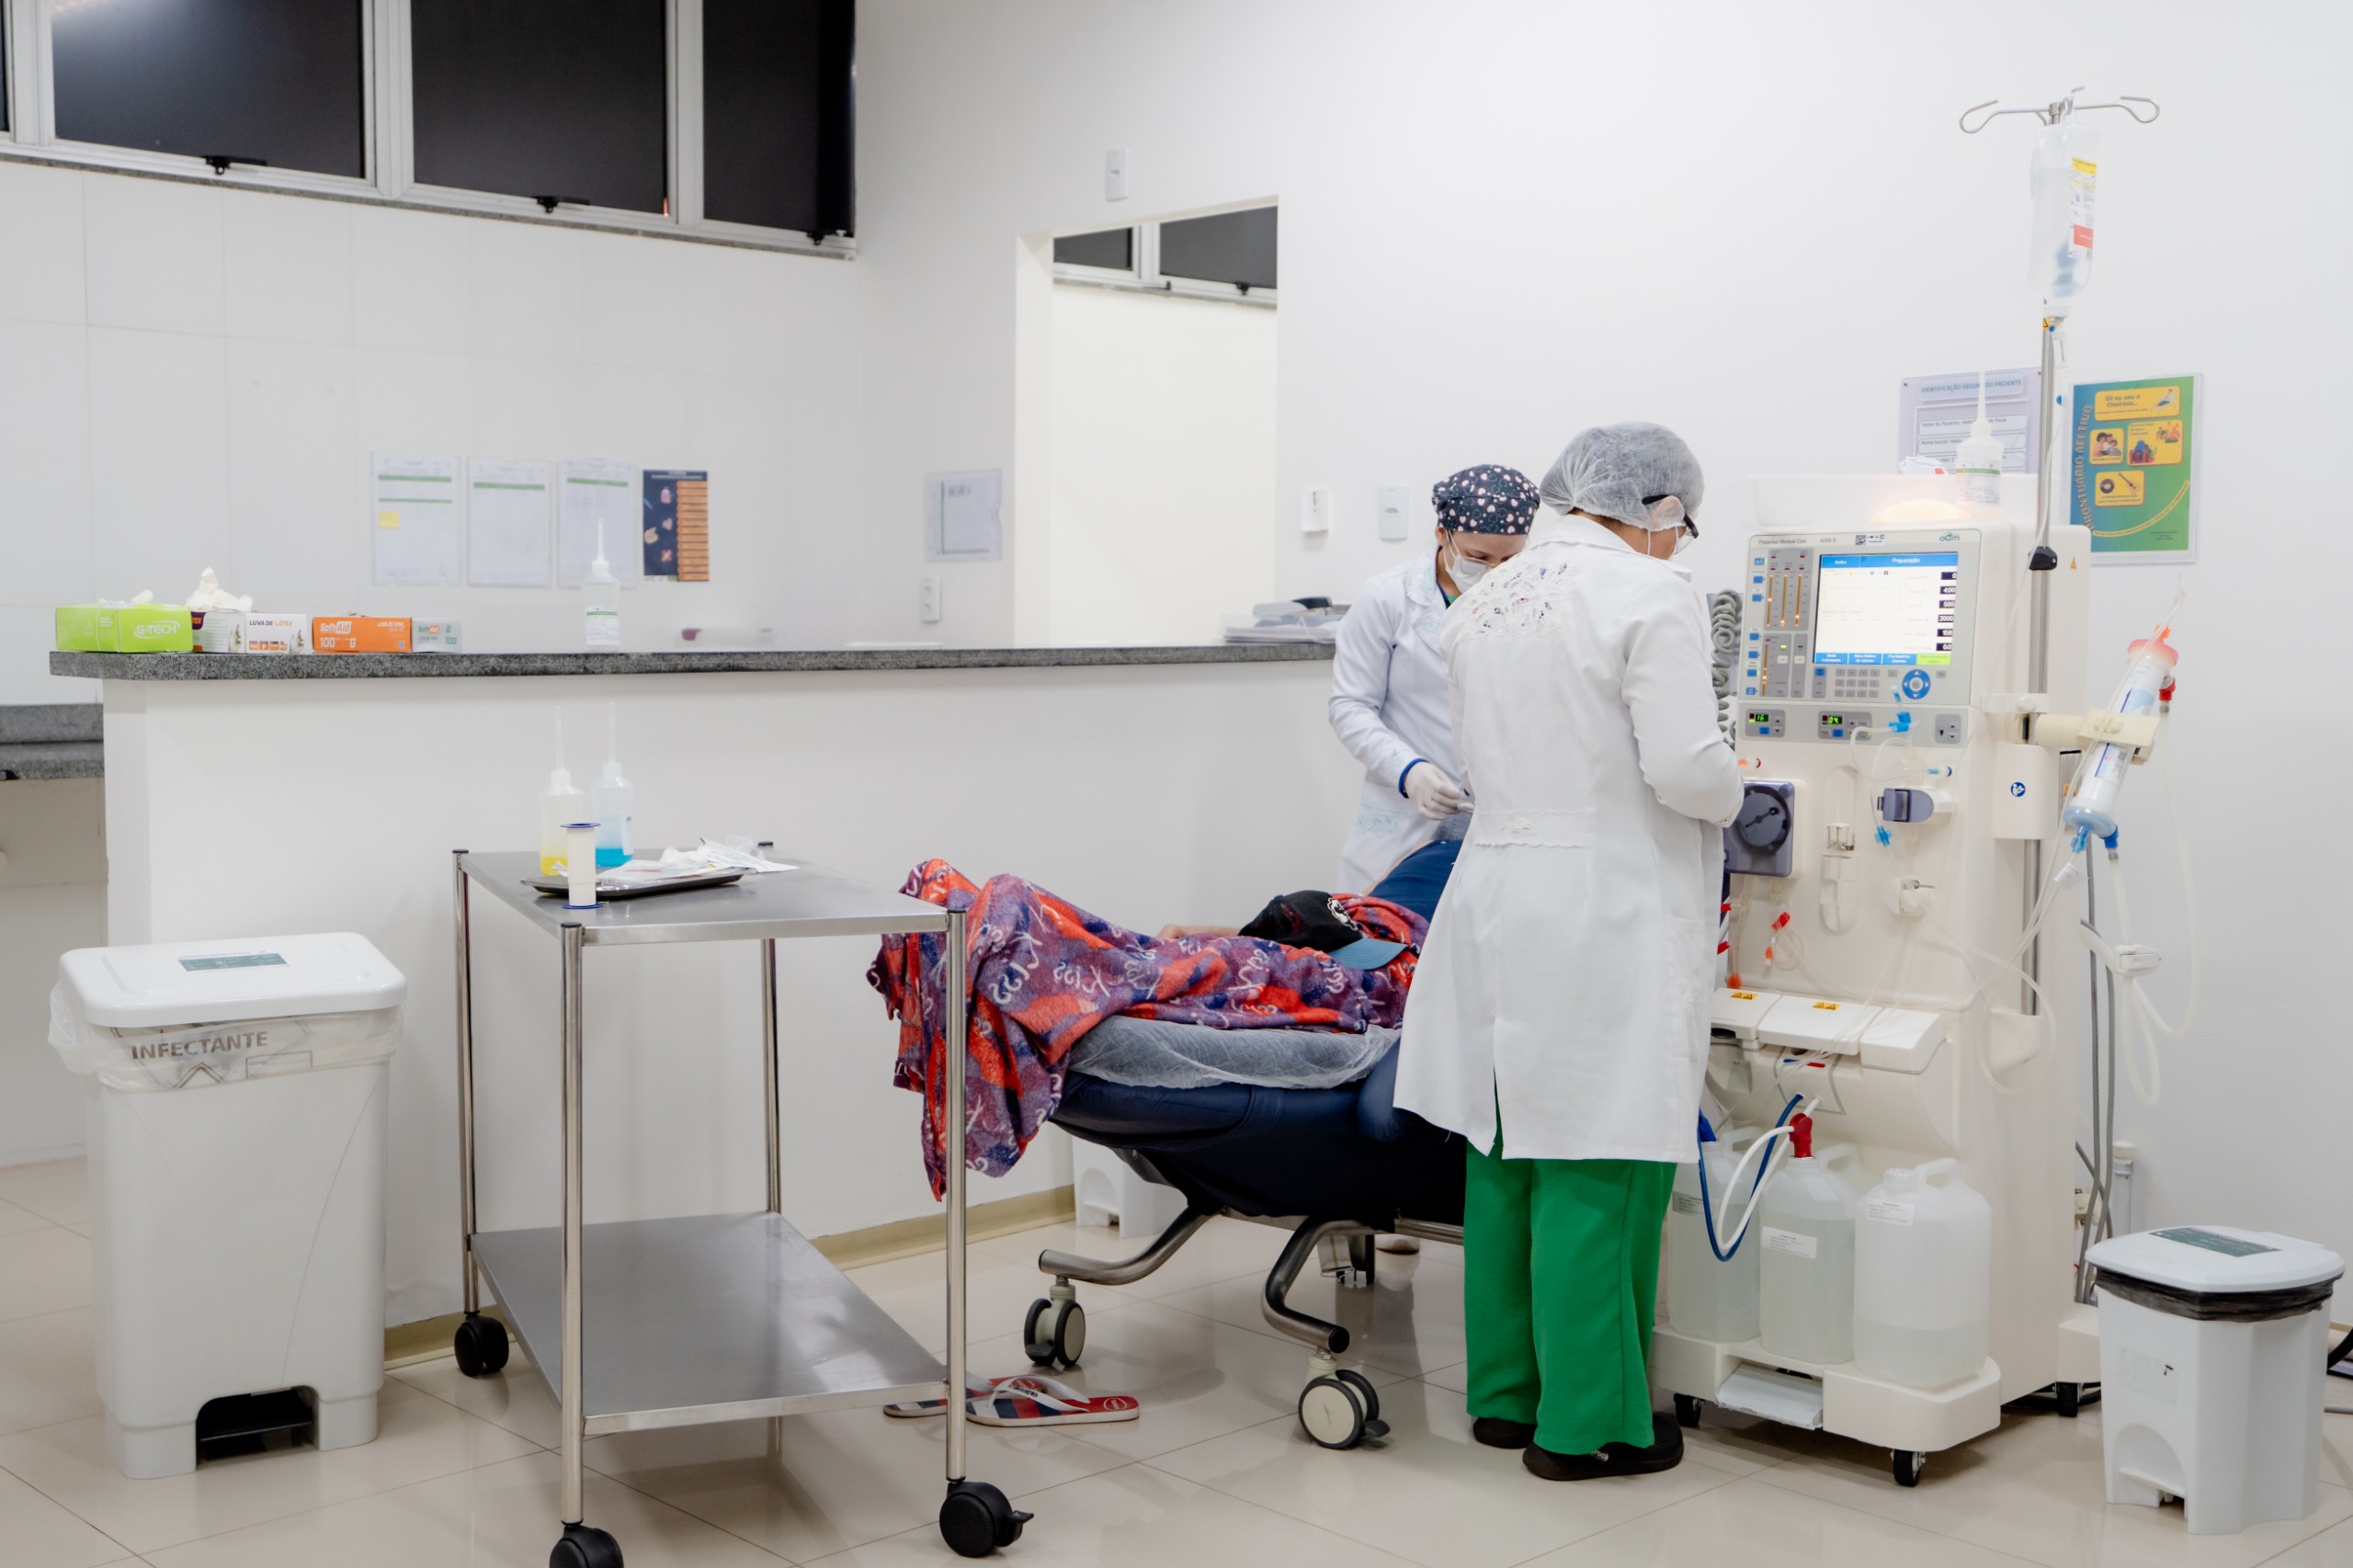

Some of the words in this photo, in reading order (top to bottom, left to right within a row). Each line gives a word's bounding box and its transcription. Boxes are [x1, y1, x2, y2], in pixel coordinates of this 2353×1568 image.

[1921, 383, 1961, 392] IDENTIFICAÇÃO
[136, 624, 176, 634] G-TECH
[320, 637, 335, 648] 100
[131, 1030, 268, 1060] INFECTANTE
